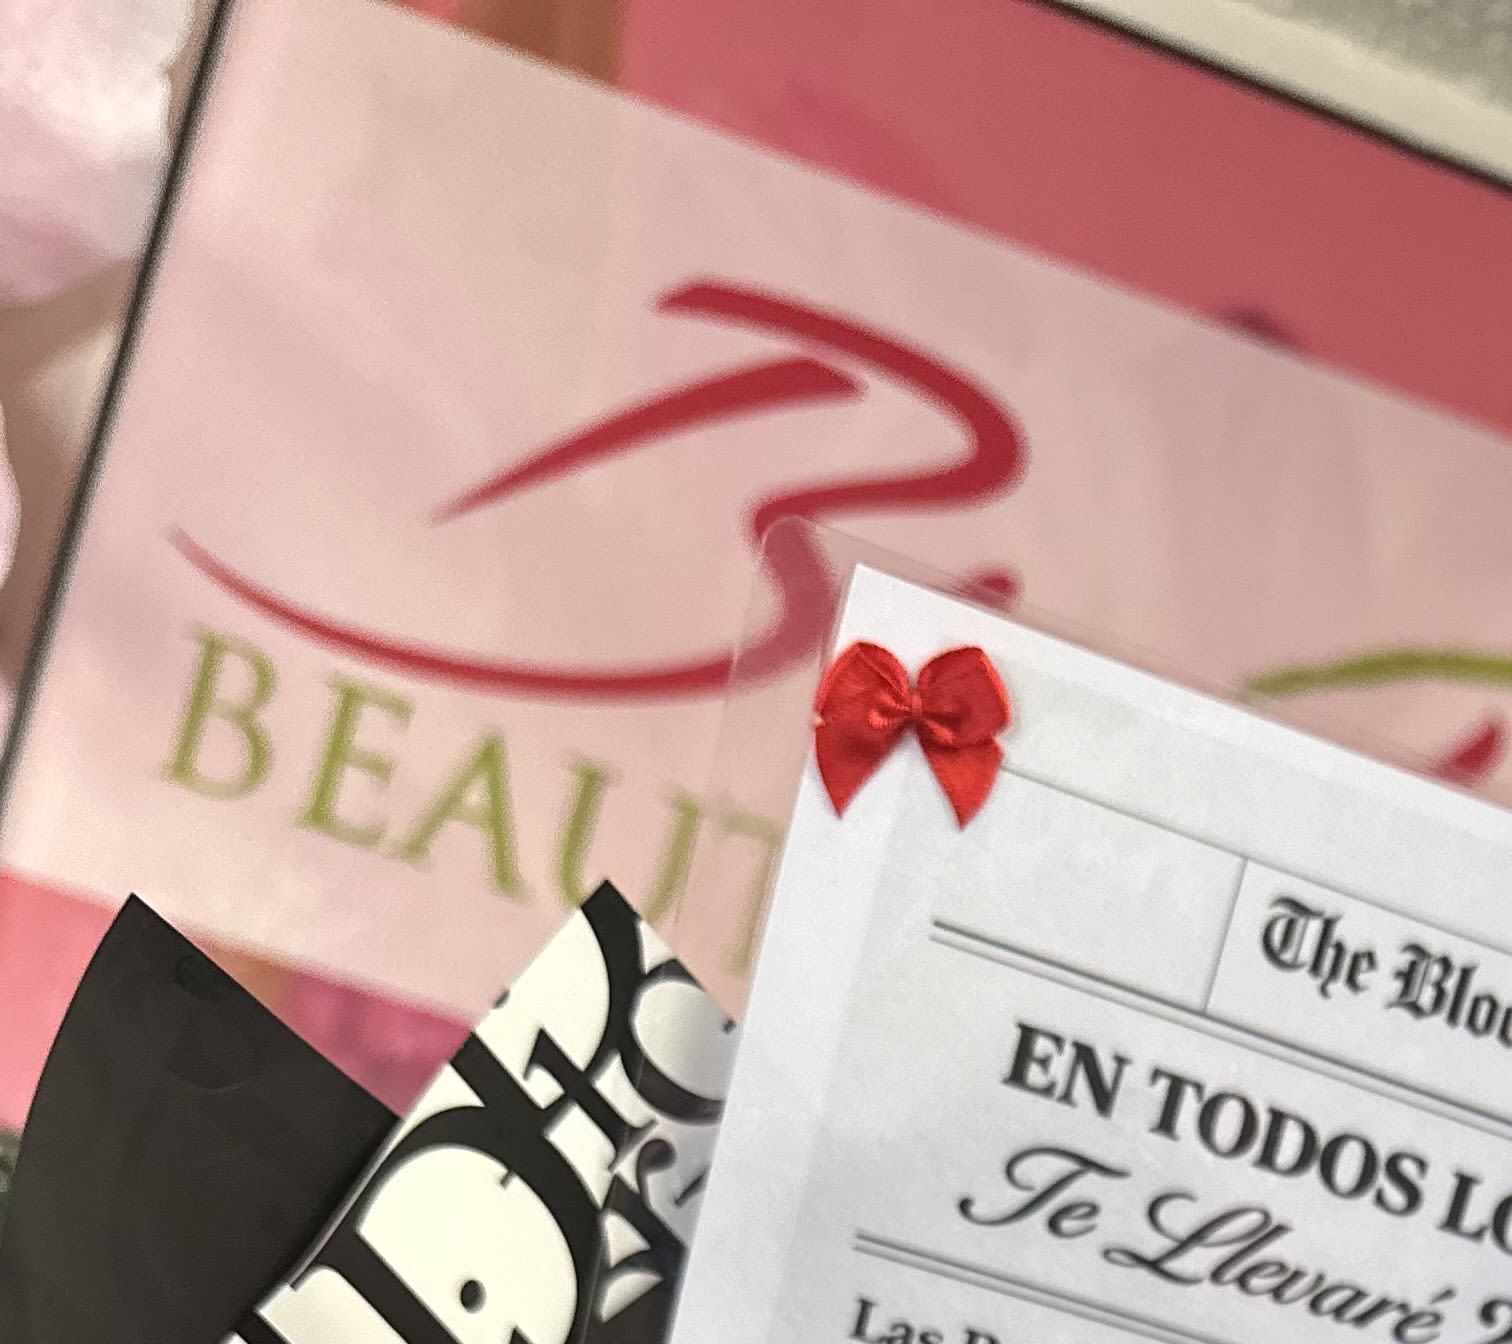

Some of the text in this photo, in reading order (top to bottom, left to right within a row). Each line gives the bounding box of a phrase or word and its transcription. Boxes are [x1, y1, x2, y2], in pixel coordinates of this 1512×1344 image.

[1259, 894, 1379, 1000] The
[1001, 1020, 1132, 1118] EN
[1147, 1066, 1428, 1219] TODOS
[957, 1143, 1129, 1242] Te
